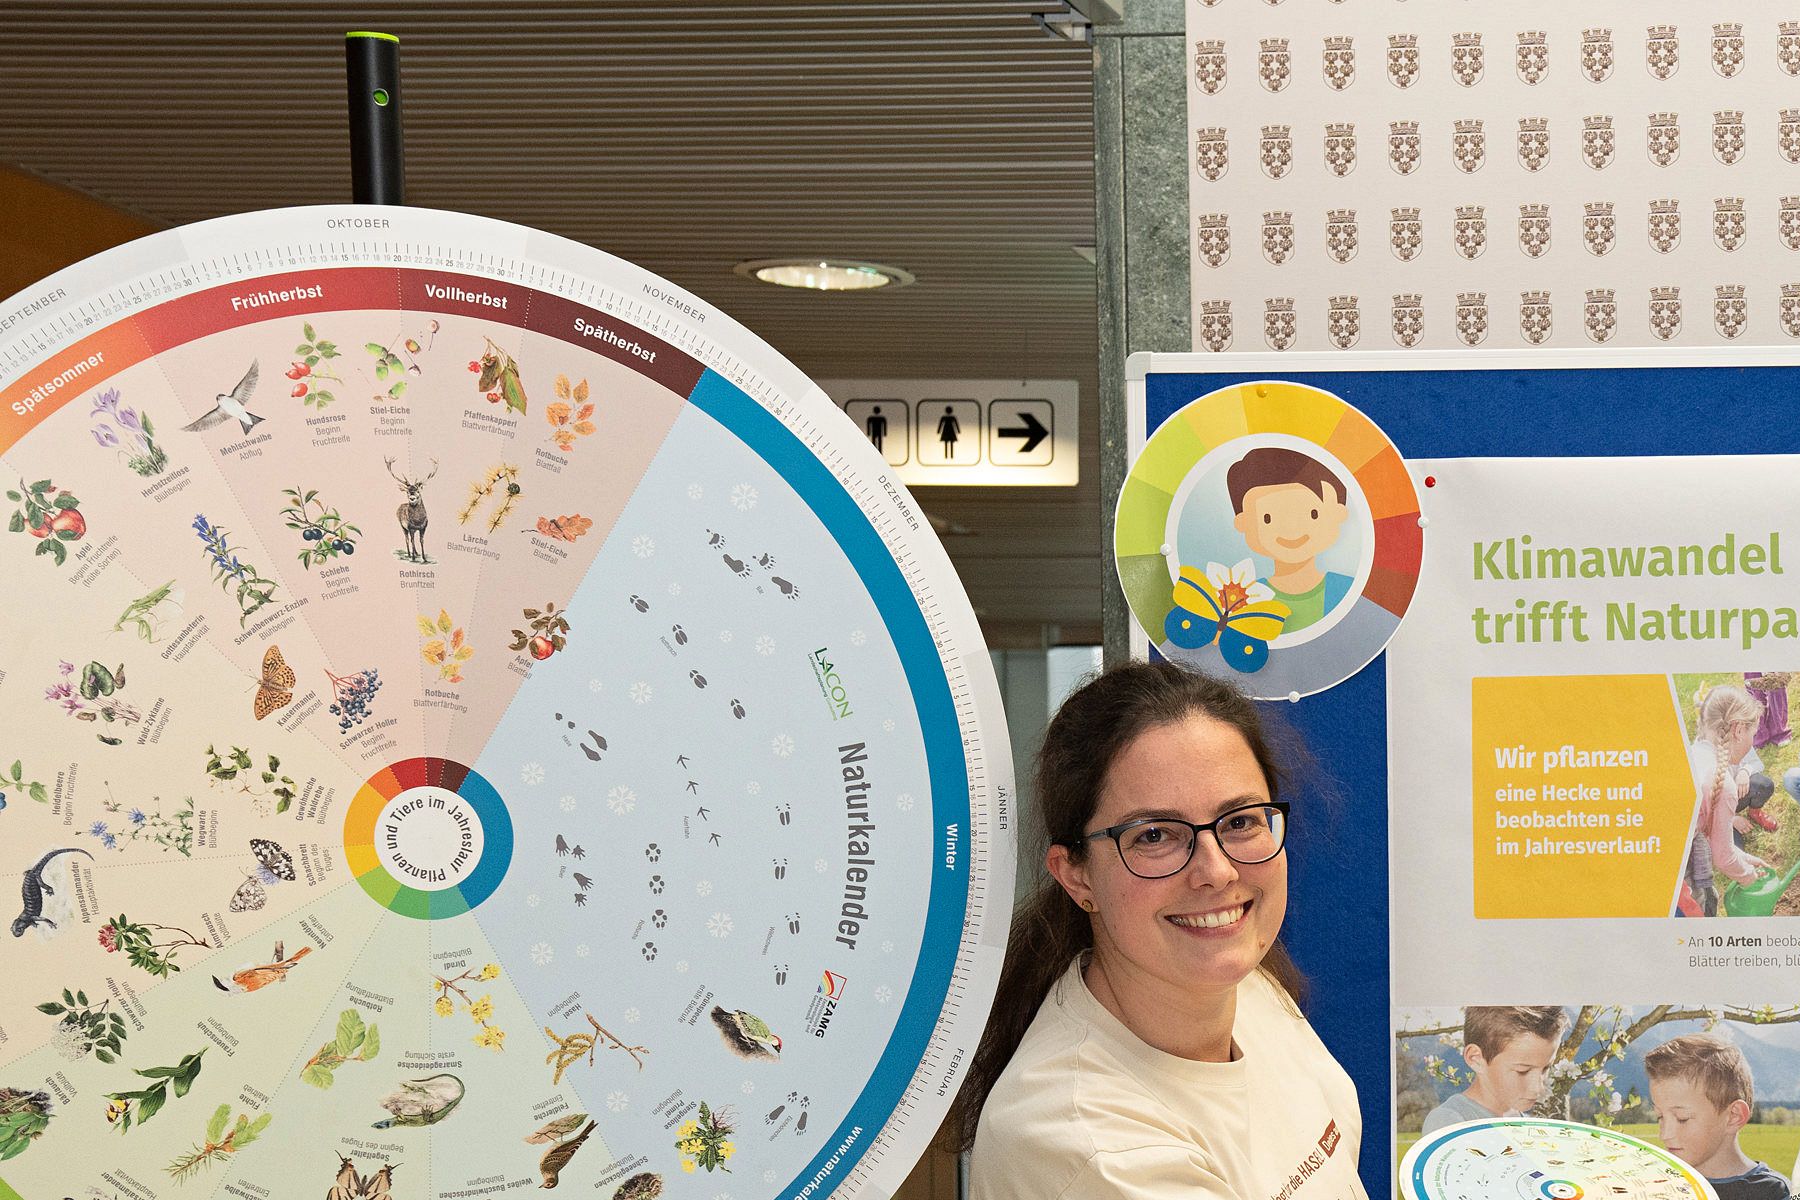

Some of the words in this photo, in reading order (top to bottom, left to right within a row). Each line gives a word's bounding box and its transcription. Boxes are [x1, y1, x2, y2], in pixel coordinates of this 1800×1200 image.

[327, 219, 390, 229] OKTOBER
[231, 283, 323, 312] Frühherbst
[425, 283, 508, 310] Vollherbst
[642, 283, 706, 323] NOVEMBER
[573, 317, 657, 365] Spätherbst
[11, 352, 105, 416] Spätsommer
[305, 413, 346, 426] Hundsrose
[370, 406, 411, 415] Stiel-Eiche
[463, 409, 517, 428] Pfaffenkapperl
[219, 432, 273, 457] Mehlschwalbe
[535, 447, 568, 465] Rotbuche
[140, 465, 190, 499] Herbstzeitlose
[878, 475, 919, 532] DEZEMBER
[75, 542, 93, 561] Apfel
[463, 533, 488, 546] Lärche
[530, 537, 568, 559] Stiel-Eiche
[1473, 533, 1783, 580] Klimawandel
[319, 565, 350, 579] Schlehe
[399, 570, 435, 579] Rothirsch
[1472, 598, 1590, 644] trifft
[160, 613, 206, 661] Gottesanbeterin
[514, 654, 534, 669] Apfel
[425, 688, 460, 700] Rotbuche
[814, 647, 853, 719] LACON
[276, 690, 317, 728] Kaisermantel
[339, 726, 376, 750] Schwarzer
[375, 716, 398, 733] Holler
[1495, 745, 1536, 768] Wir
[1543, 745, 1648, 774] pflanzen
[52, 770, 65, 816] Heidelbeere
[295, 777, 317, 821] Gewöhnliche
[307, 784, 325, 819] Waldrebe
[428, 796, 445, 810] im
[1496, 783, 1536, 801] eine
[1543, 783, 1600, 801] Hecke
[1606, 782, 1643, 801] und
[390, 797, 424, 822] Tiere
[997, 785, 1007, 830] JÄNNER
[1496, 810, 1610, 828] beobachten
[1615, 808, 1643, 827] sie
[198, 809, 207, 847] Wegwarte
[386, 824, 399, 850] und
[447, 806, 473, 874] Jahreslauf
[835, 741, 876, 951] Naturkalender
[945, 824, 957, 870] Winter
[1496, 836, 1518, 855] im
[1525, 836, 1661, 858] Jahresverlauf!
[301, 843, 317, 887] Schachbrett
[389, 852, 446, 883] Pflanzen
[72, 861, 90, 924] Alpensalamander
[200, 912, 223, 949] Almrausch
[299, 920, 327, 949] Neuntöter
[1688, 936, 1704, 948] An
[1708, 936, 1723, 948] 10
[1726, 936, 1762, 948] Arten
[444, 960, 466, 970] Dirndl
[1689, 955, 1731, 968] Blätter
[1734, 955, 1781, 970] treiben,
[105, 976, 123, 999] Holler
[117, 996, 145, 1032] Schwarzer
[349, 995, 383, 1013] Rotbuche
[562, 1002, 582, 1020] Hasel
[688, 991, 714, 1027] Grünspecht
[815, 1000, 837, 1039] ZAMG
[197, 1020, 235, 1057] Frauenschuh
[397, 1061, 463, 1070] Smaragdeidechse
[937, 1048, 964, 1097] FEBRUAR
[45, 1076, 71, 1105] Bärlauch
[239, 1094, 260, 1110] Fichte
[534, 1102, 569, 1120] Feldlerche
[664, 1101, 697, 1131] Stengellose
[350, 1149, 390, 1161] Segelfalter
[505, 1177, 533, 1190] Weißes
[594, 1155, 648, 1188] Schneeglöckchen
[439, 1182, 506, 1199] Buschwindröschen
